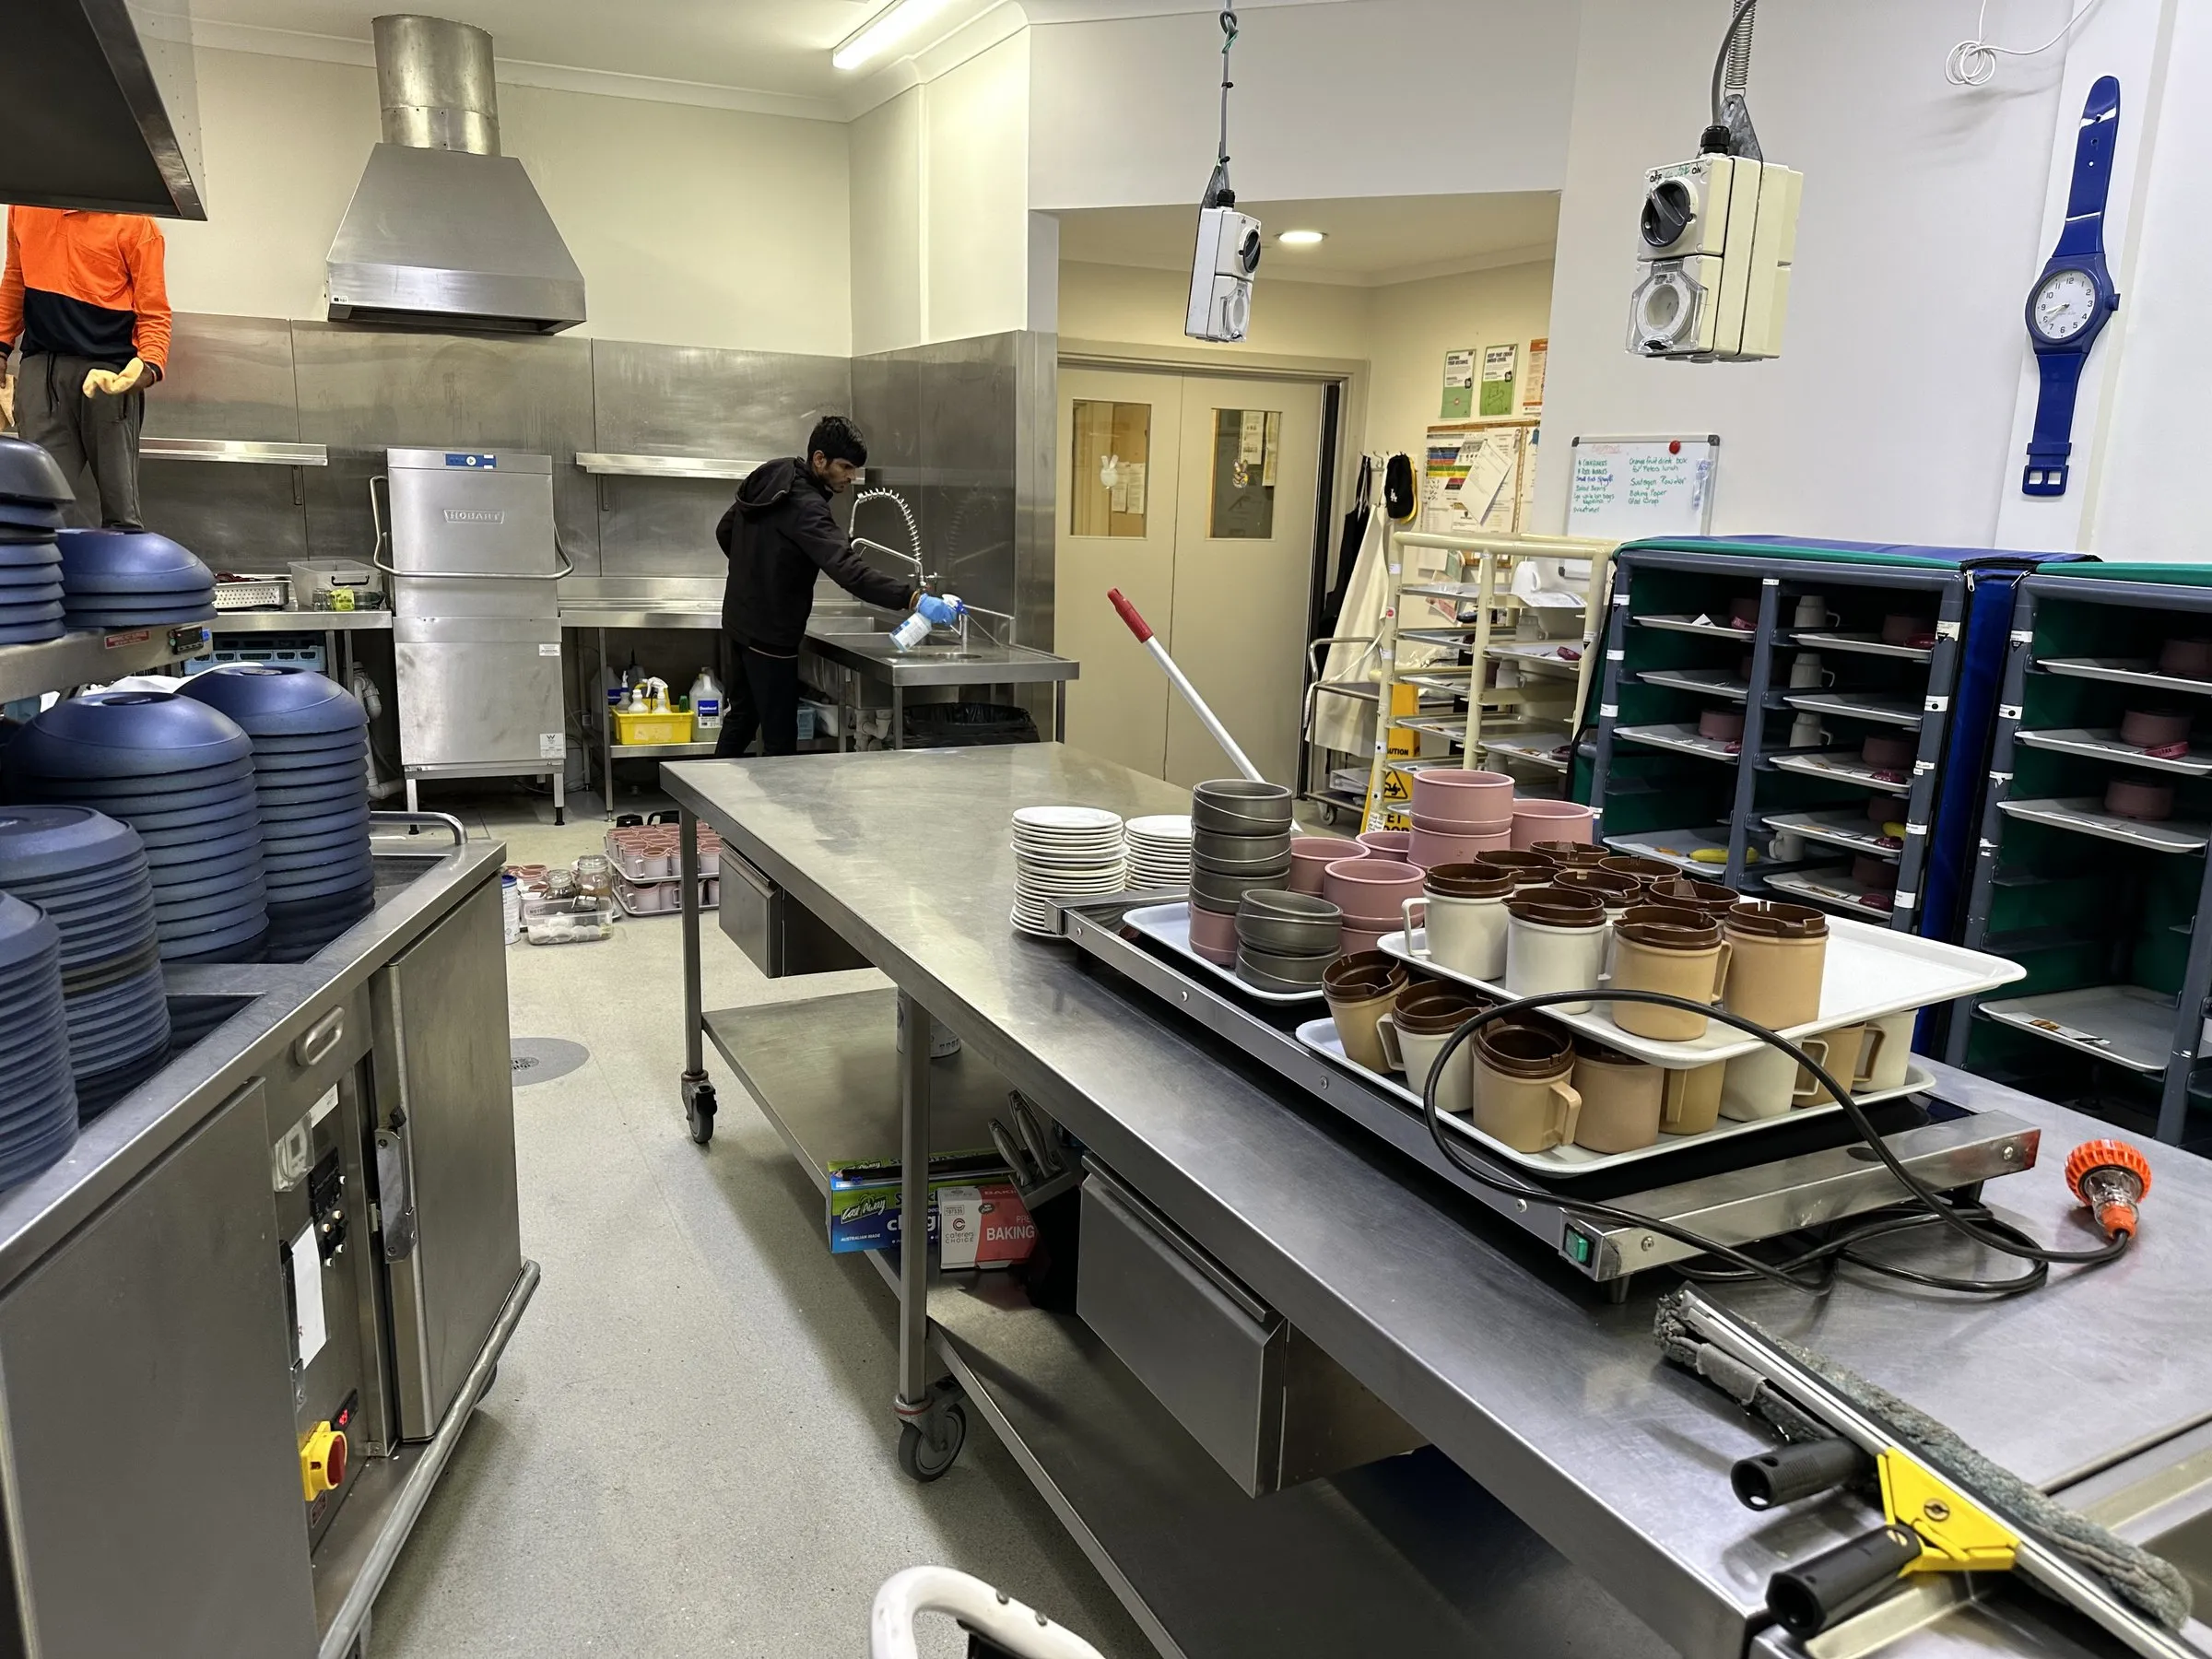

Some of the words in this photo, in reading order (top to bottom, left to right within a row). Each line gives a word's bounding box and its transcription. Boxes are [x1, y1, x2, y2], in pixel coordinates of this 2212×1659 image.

[2087, 300, 2093, 308] 3
[841, 1206, 861, 1221] Cast
[863, 1199, 886, 1216] Away
[841, 1234, 868, 1242] AUSTRALIAN
[986, 1225, 1035, 1241] BAKING
